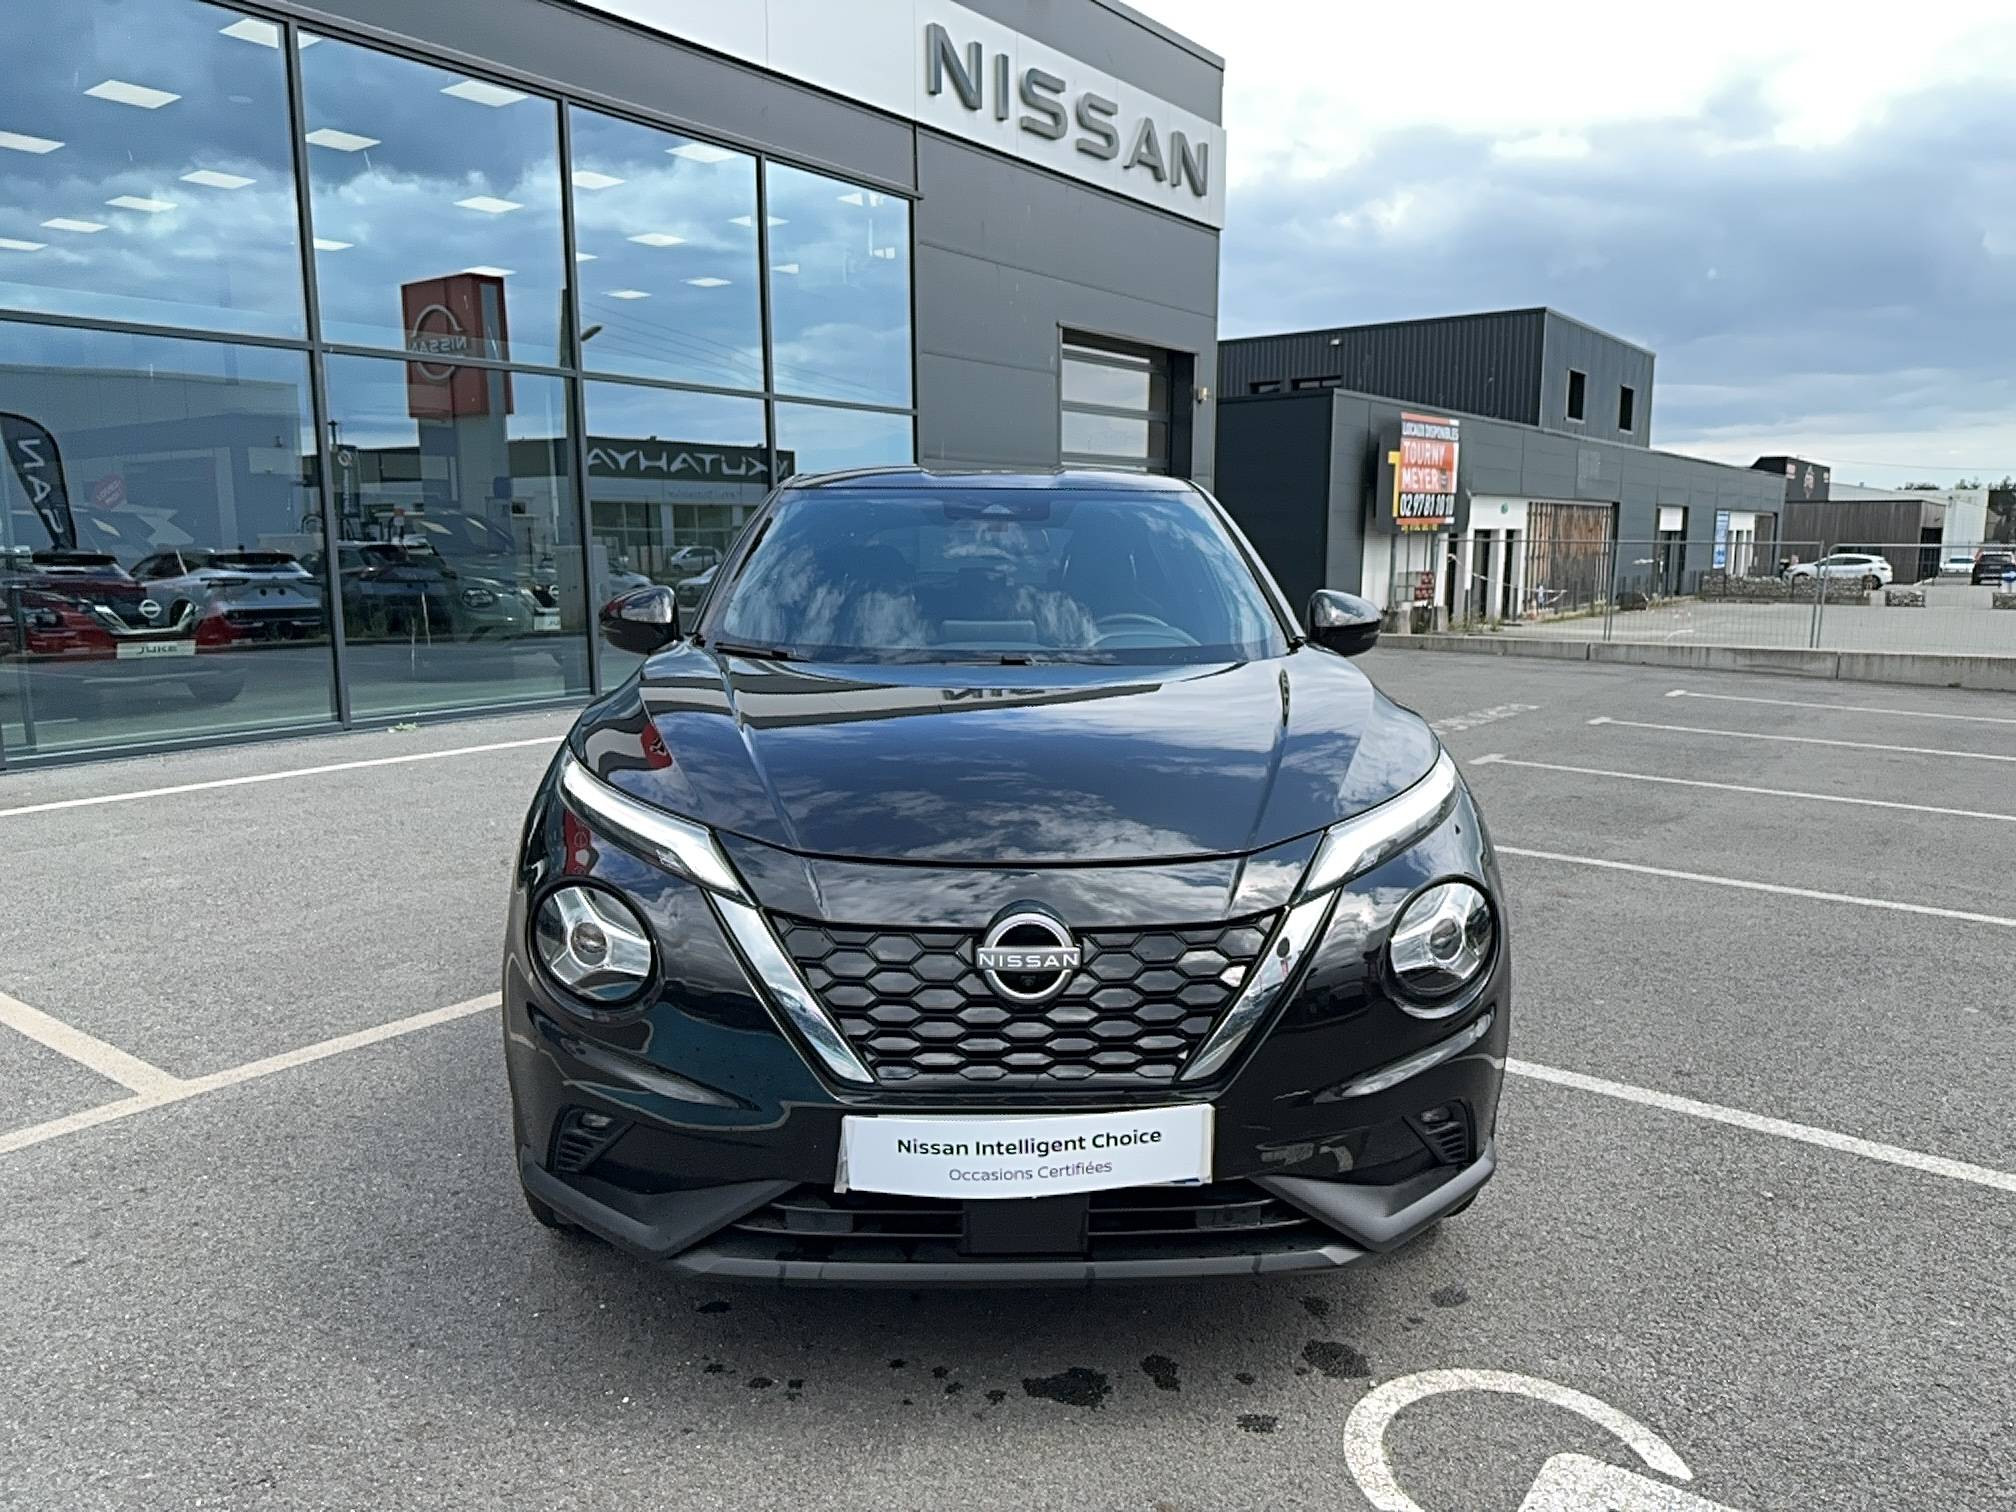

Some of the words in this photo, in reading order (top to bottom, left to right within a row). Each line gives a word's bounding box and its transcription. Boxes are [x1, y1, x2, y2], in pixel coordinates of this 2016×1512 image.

[926, 22, 1209, 198] NISSAN
[1403, 440, 1446, 466] TOURNY
[1402, 466, 1439, 490] MEYER
[136, 645, 178, 655] JUKE
[979, 953, 1078, 968] NISSAN
[897, 1138, 969, 1156] Nissan
[976, 1135, 1086, 1158] Intelligent
[1092, 1129, 1162, 1149] Choice
[949, 1167, 1033, 1182] Occasions
[1037, 1160, 1113, 1179] Certifiées
